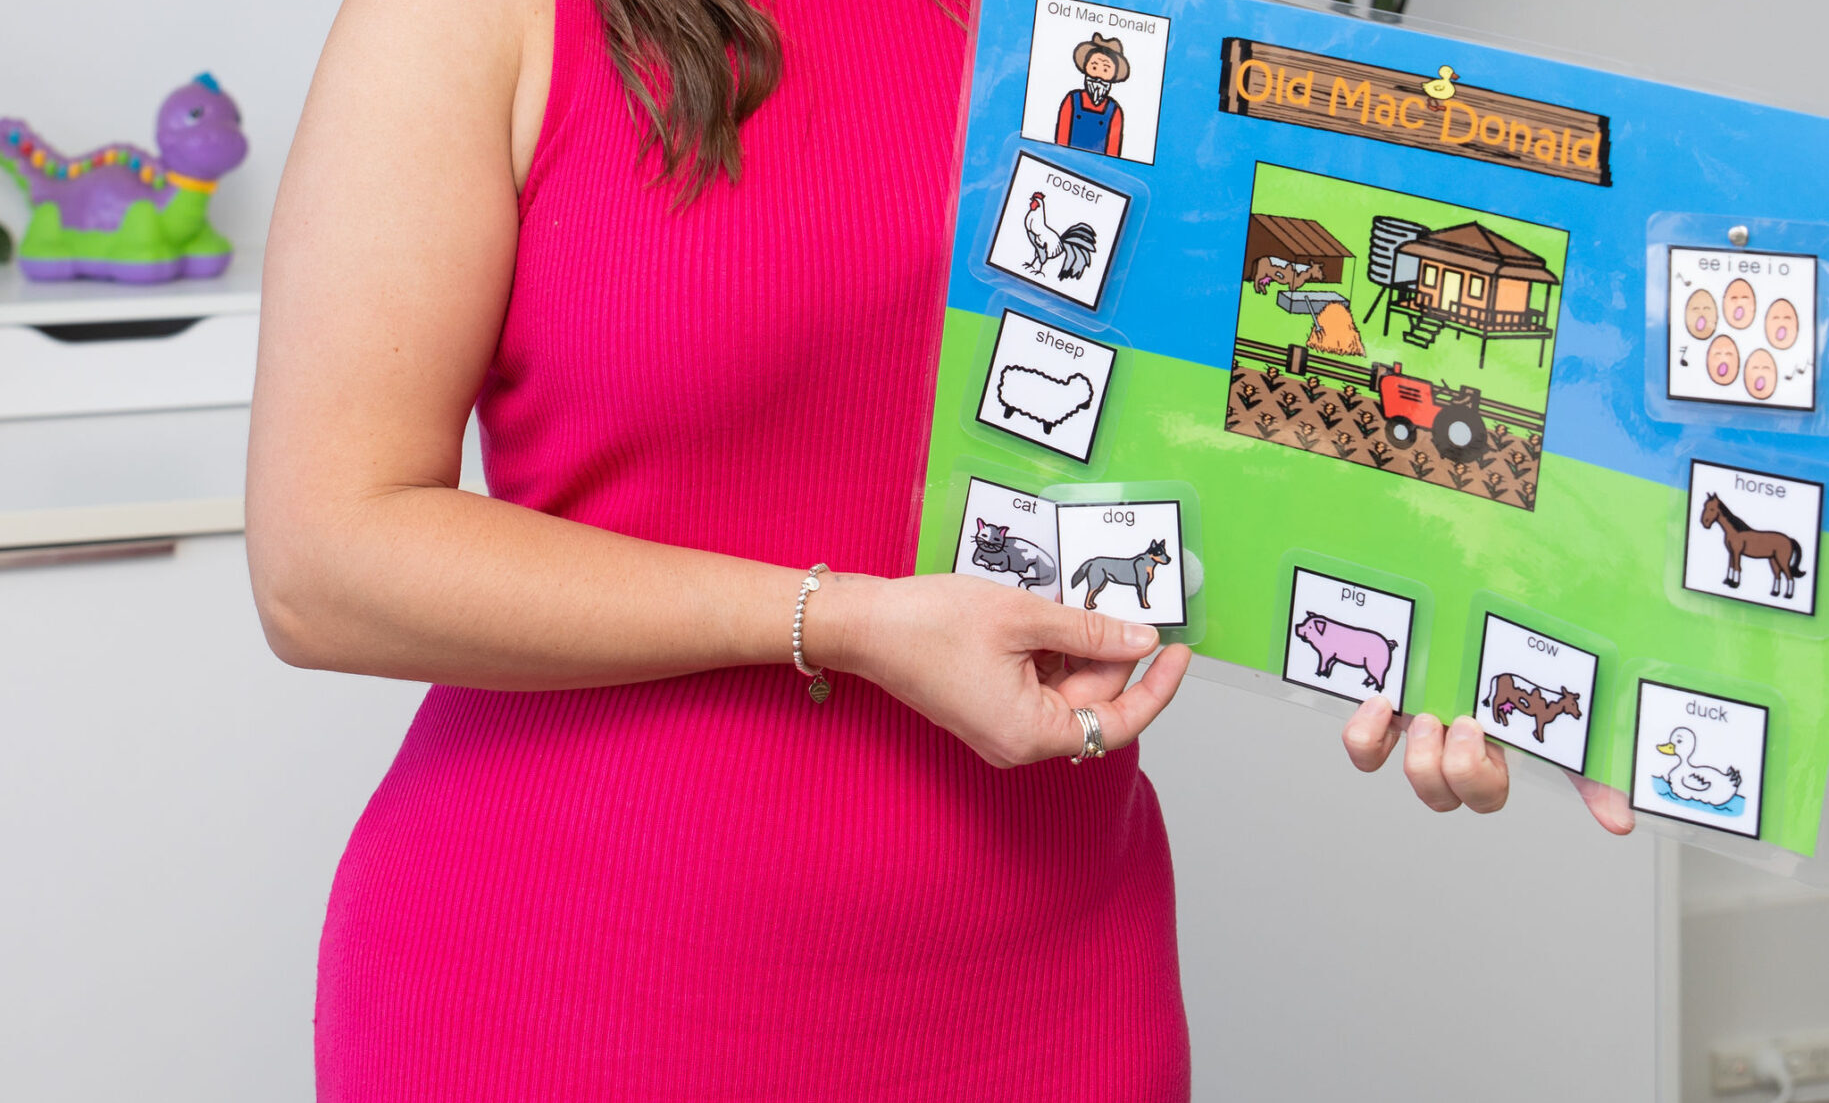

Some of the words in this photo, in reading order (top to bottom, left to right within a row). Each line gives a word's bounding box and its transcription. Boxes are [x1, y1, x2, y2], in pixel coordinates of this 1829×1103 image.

[1048, 2, 1072, 17] Old
[1076, 7, 1104, 24] Mac
[1109, 13, 1156, 34] Donald
[1236, 59, 1314, 107] Old
[1328, 77, 1427, 130] Mac
[1440, 101, 1602, 170] Donald
[1046, 173, 1102, 204] rooster
[1699, 257, 1720, 271] ee
[1738, 260, 1760, 274] ee
[1778, 263, 1789, 276] o
[1036, 331, 1084, 359] sheep
[1735, 474, 1786, 498] horse
[1012, 498, 1037, 514] cat
[1103, 508, 1135, 526] dog
[1341, 586, 1366, 606] pig
[1527, 636, 1559, 657] cow
[1685, 700, 1728, 723] duck
